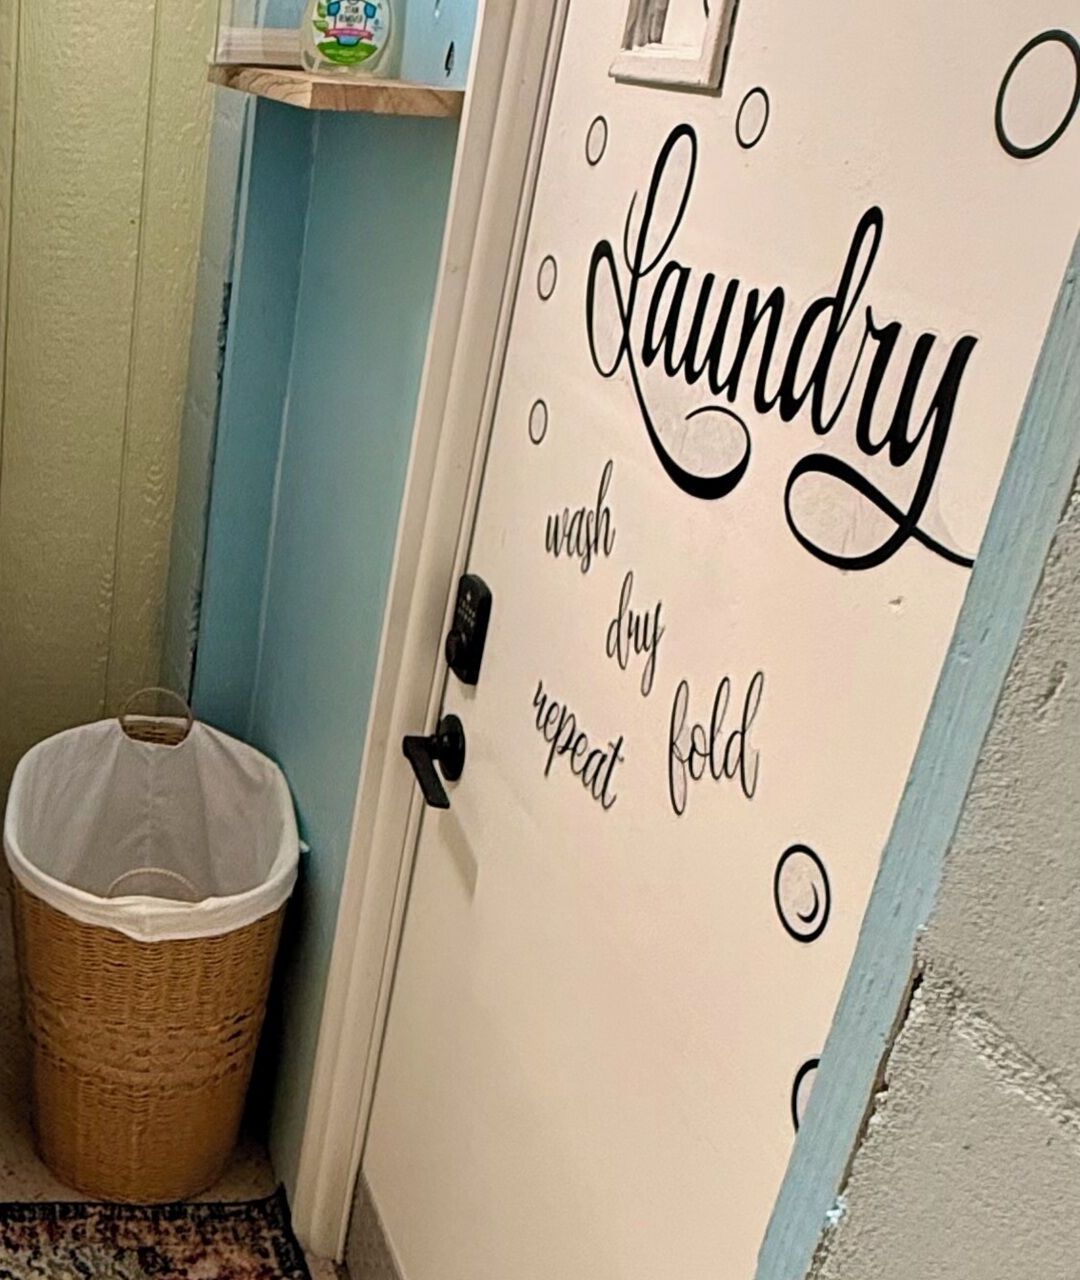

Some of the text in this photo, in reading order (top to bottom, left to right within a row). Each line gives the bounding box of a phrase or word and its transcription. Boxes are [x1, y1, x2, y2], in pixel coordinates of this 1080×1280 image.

[585, 123, 978, 571] Laundry
[545, 459, 616, 574] wash
[605, 571, 665, 696] dry
[532, 679, 625, 811] repeat
[668, 671, 765, 816] fold
